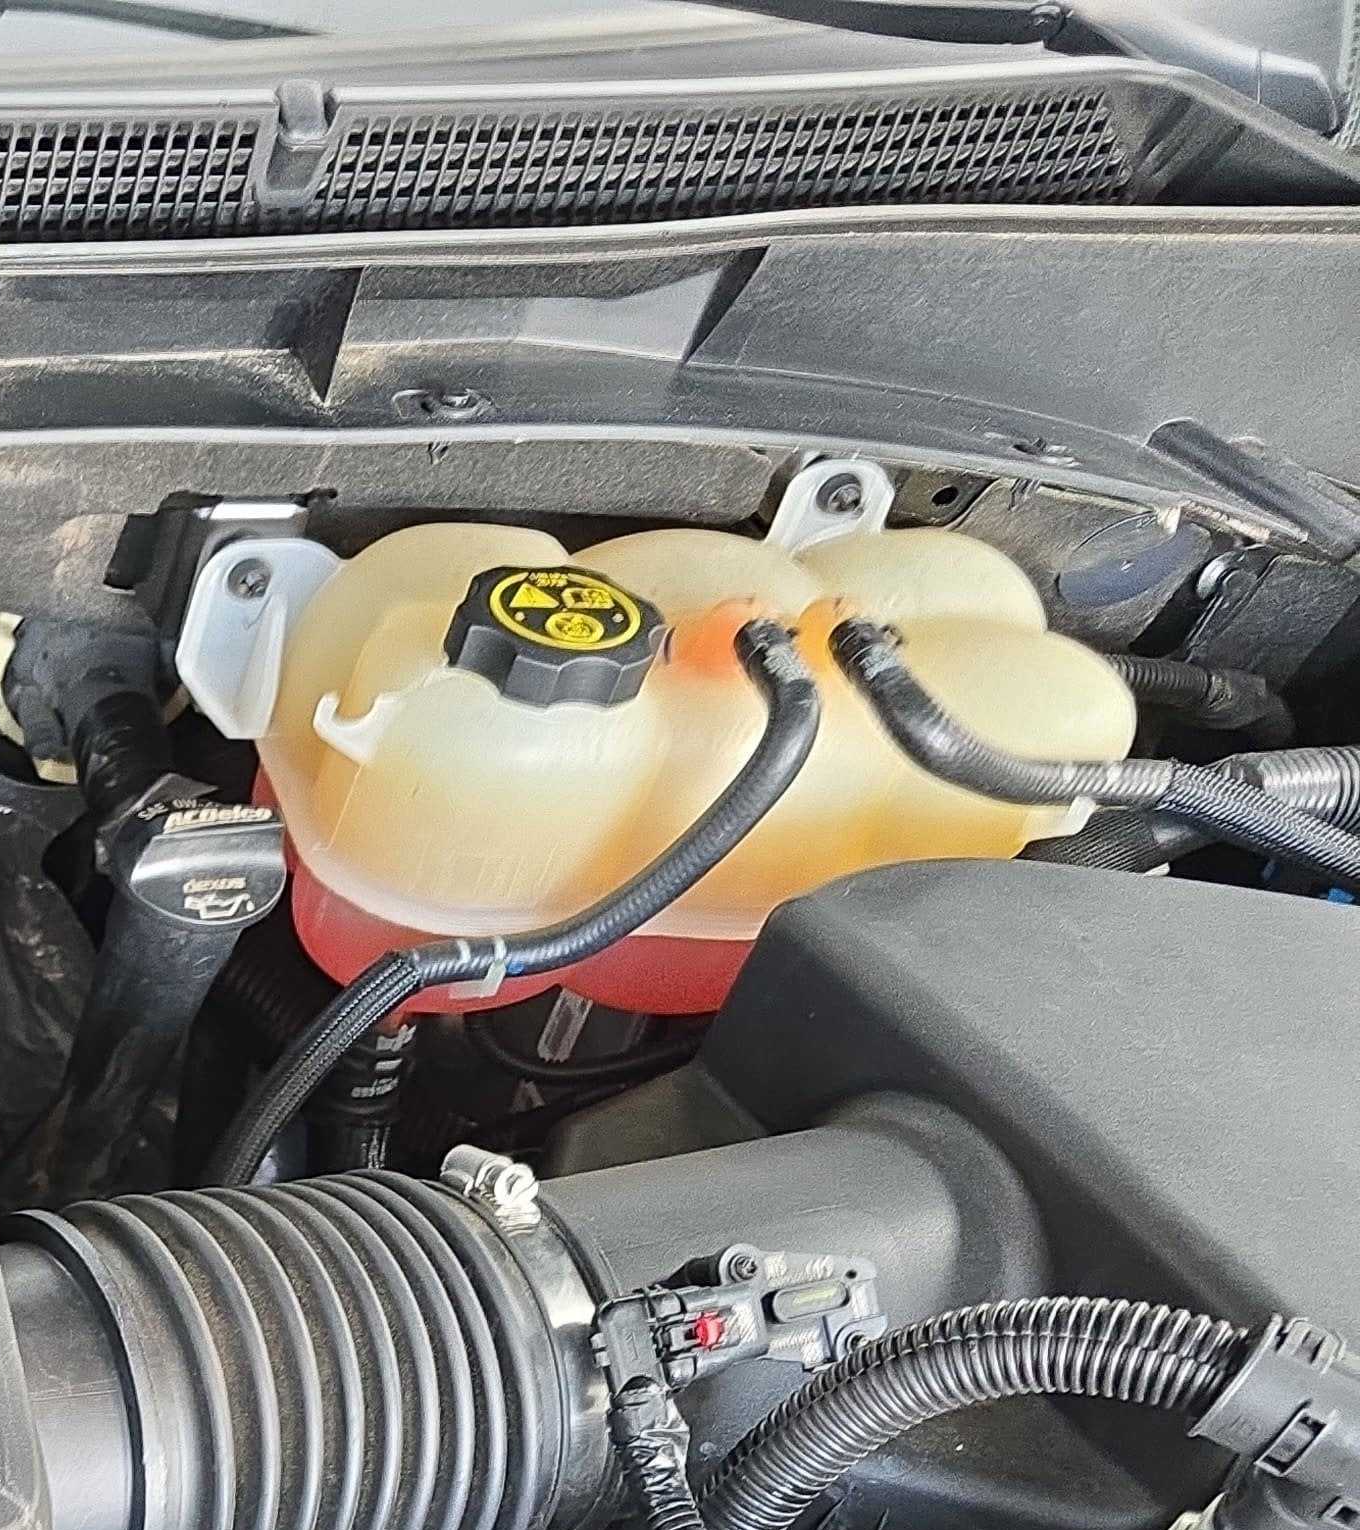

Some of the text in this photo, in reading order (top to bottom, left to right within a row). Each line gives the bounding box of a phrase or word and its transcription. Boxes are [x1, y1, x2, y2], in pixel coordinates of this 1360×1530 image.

[137, 803, 169, 821] SAE
[163, 805, 273, 831] ACDelco
[183, 877, 247, 893] dexos
